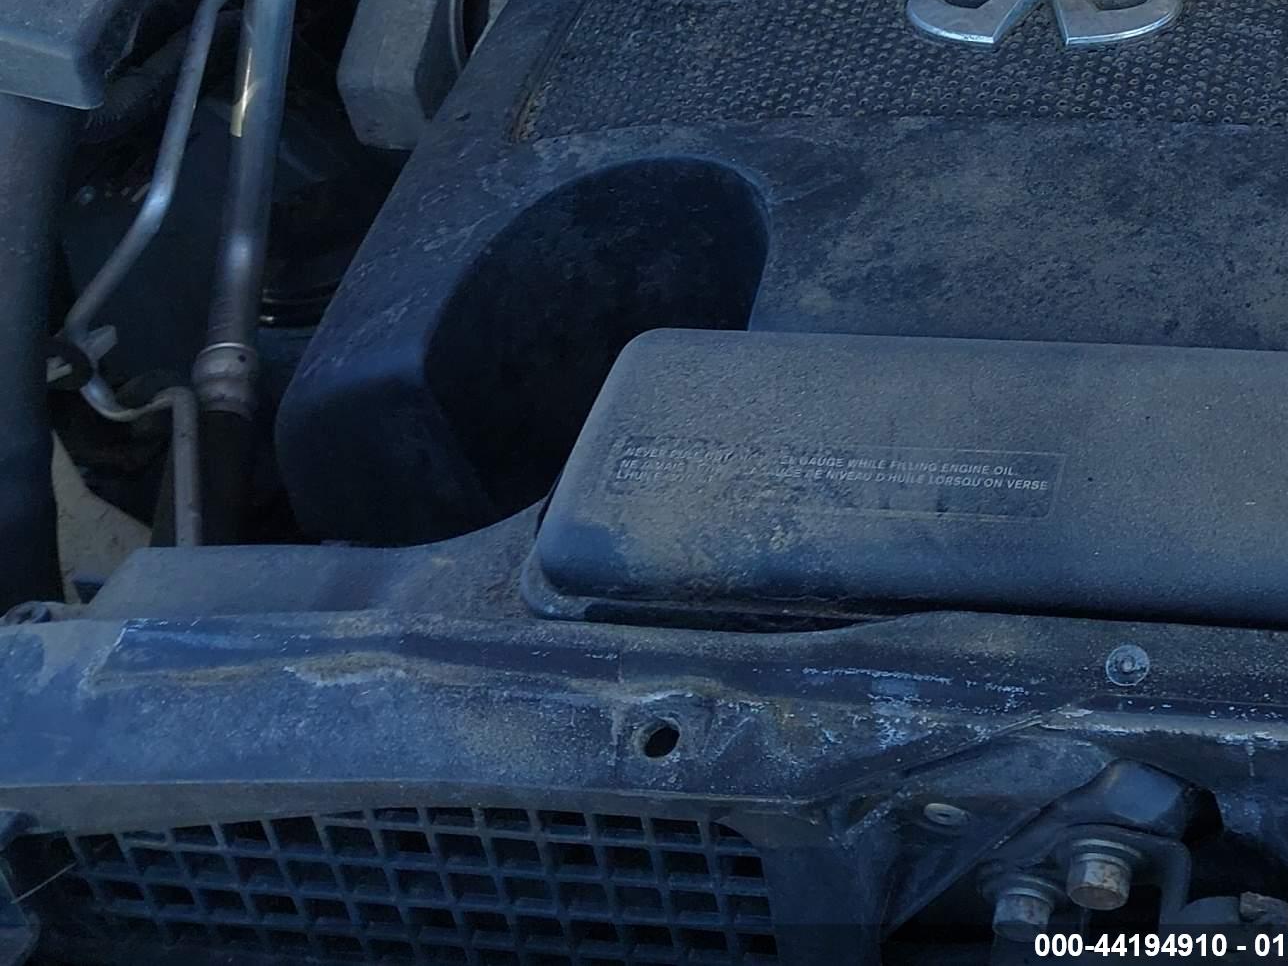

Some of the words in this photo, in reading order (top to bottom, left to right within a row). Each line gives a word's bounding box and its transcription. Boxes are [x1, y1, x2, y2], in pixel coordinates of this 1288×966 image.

[800, 456, 844, 468] GAUGE
[847, 458, 887, 470] WHILE
[889, 460, 937, 473] FILLING
[940, 462, 990, 475] ENGINE
[825, 469, 872, 482] NIVEAU
[1006, 479, 1049, 491] VERSE
